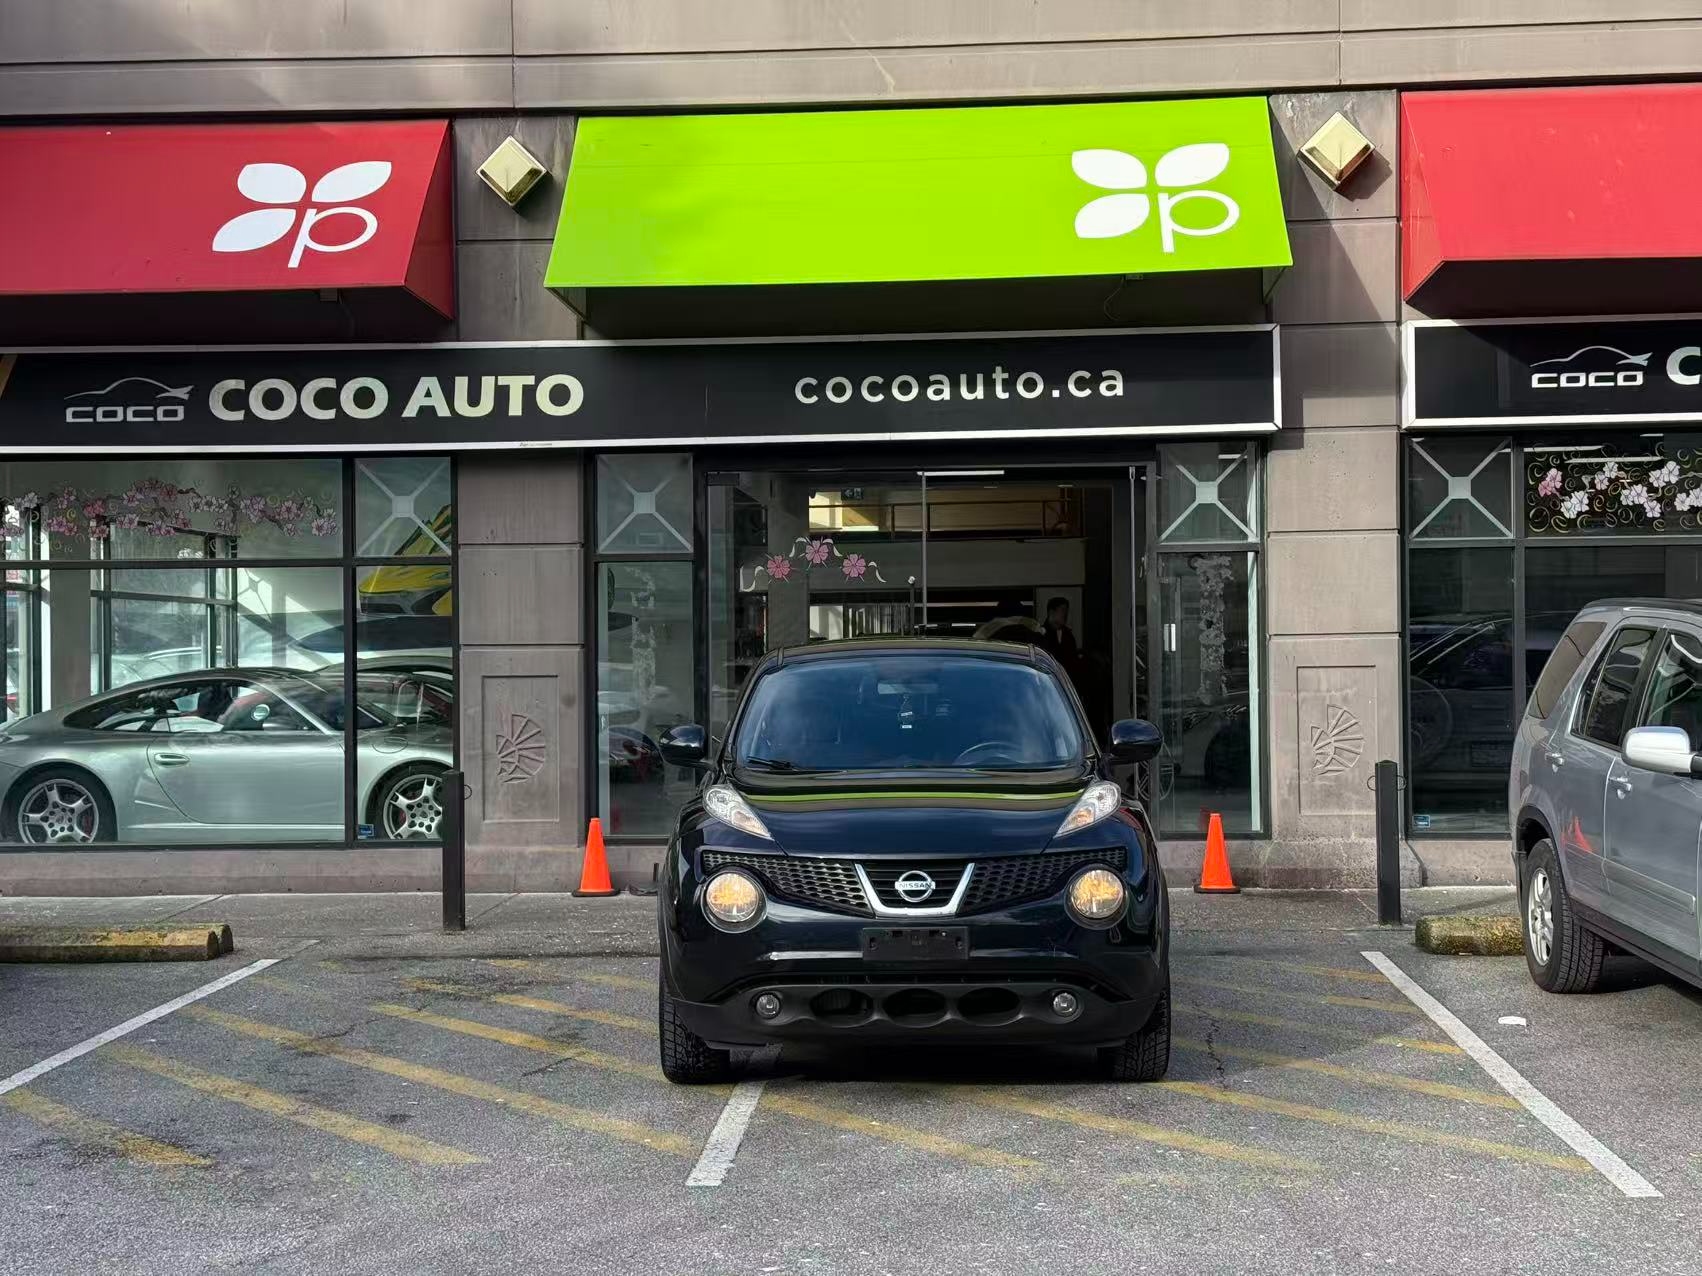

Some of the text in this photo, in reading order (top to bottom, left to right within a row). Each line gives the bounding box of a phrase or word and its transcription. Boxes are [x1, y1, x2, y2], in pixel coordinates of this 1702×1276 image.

[794, 366, 1125, 405] cocoauto.ca
[1531, 371, 1644, 388] COCO
[208, 373, 585, 421] COCO AUTO
[65, 405, 185, 423] COCO
[898, 882, 932, 890] NISSAN
